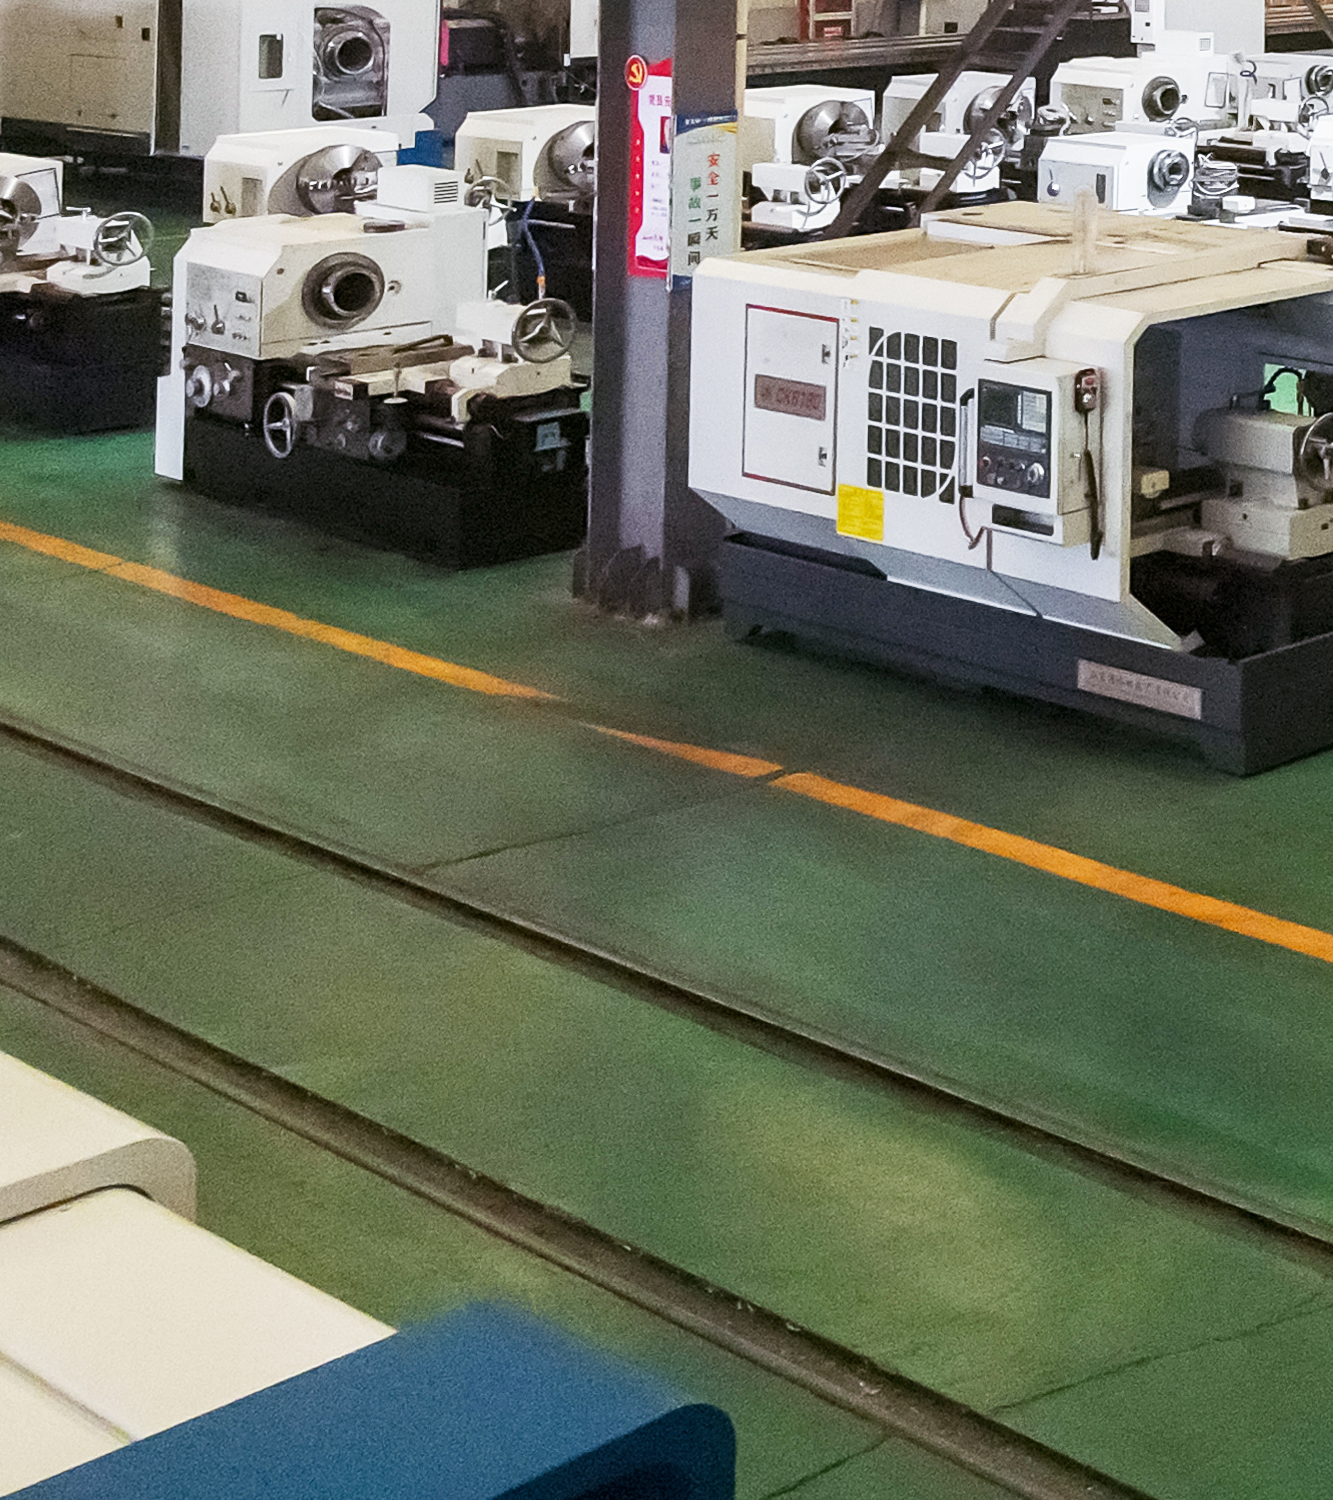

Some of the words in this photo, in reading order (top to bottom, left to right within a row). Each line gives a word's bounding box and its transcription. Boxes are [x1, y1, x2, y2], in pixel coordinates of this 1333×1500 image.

[687, 176, 702, 267] 事故一瞬间
[705, 153, 721, 242] 安全一万天
